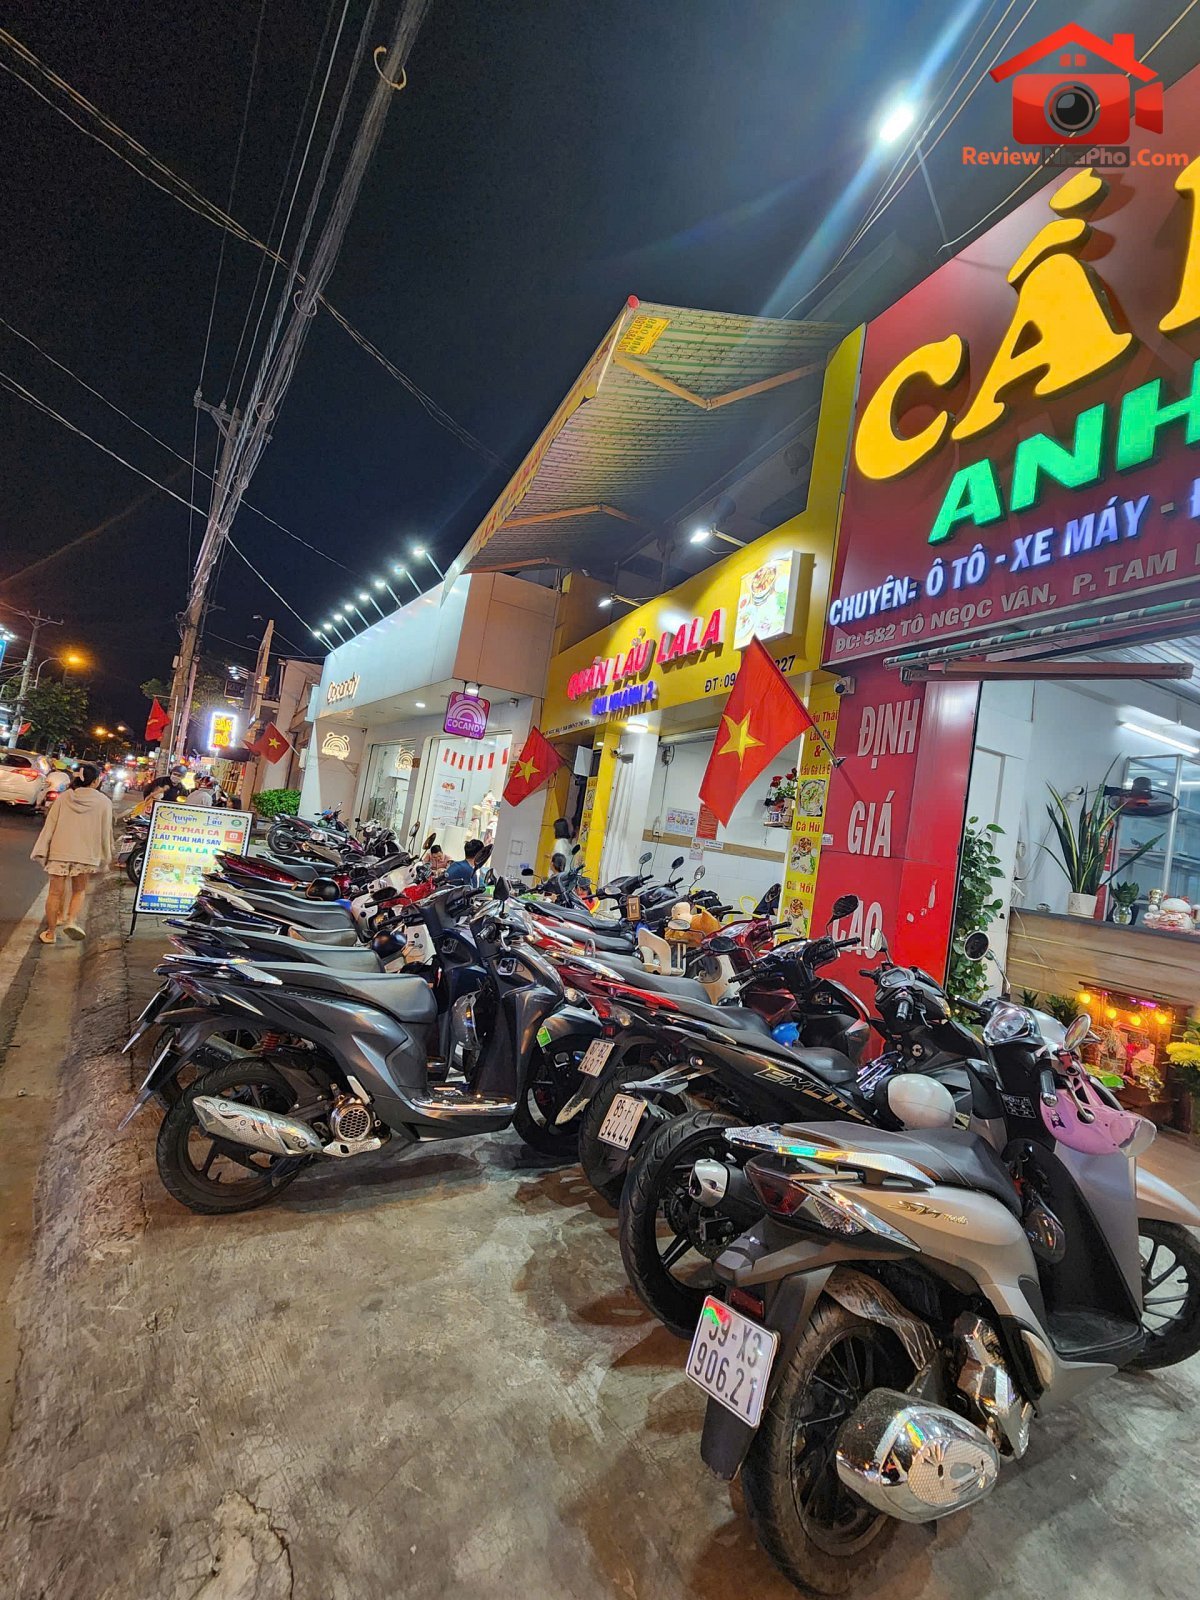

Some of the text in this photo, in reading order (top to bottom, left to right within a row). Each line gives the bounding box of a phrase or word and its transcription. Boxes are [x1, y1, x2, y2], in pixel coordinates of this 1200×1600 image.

[855, 153, 1200, 480] CẦ
[829, 575, 917, 626] CHUYÊN:
[926, 557, 944, 597] Ô
[952, 543, 986, 590] TÔ
[1010, 527, 1054, 573] XE
[1064, 495, 1150, 554] MÁY
[863, 623, 897, 646] 582
[900, 613, 925, 637] TÔ
[930, 599, 993, 630] NGỌC
[1001, 584, 1057, 612] VÂN,
[1072, 573, 1097, 596] P.
[1104, 549, 1178, 587] TAM
[656, 608, 725, 665] LALA
[646, 679, 657, 700] 2
[447, 718, 486, 733] COCANDY
[857, 699, 920, 769] ĐỊNH
[848, 790, 895, 858] GIÁ
[694, 1342, 758, 1415] 906.21
